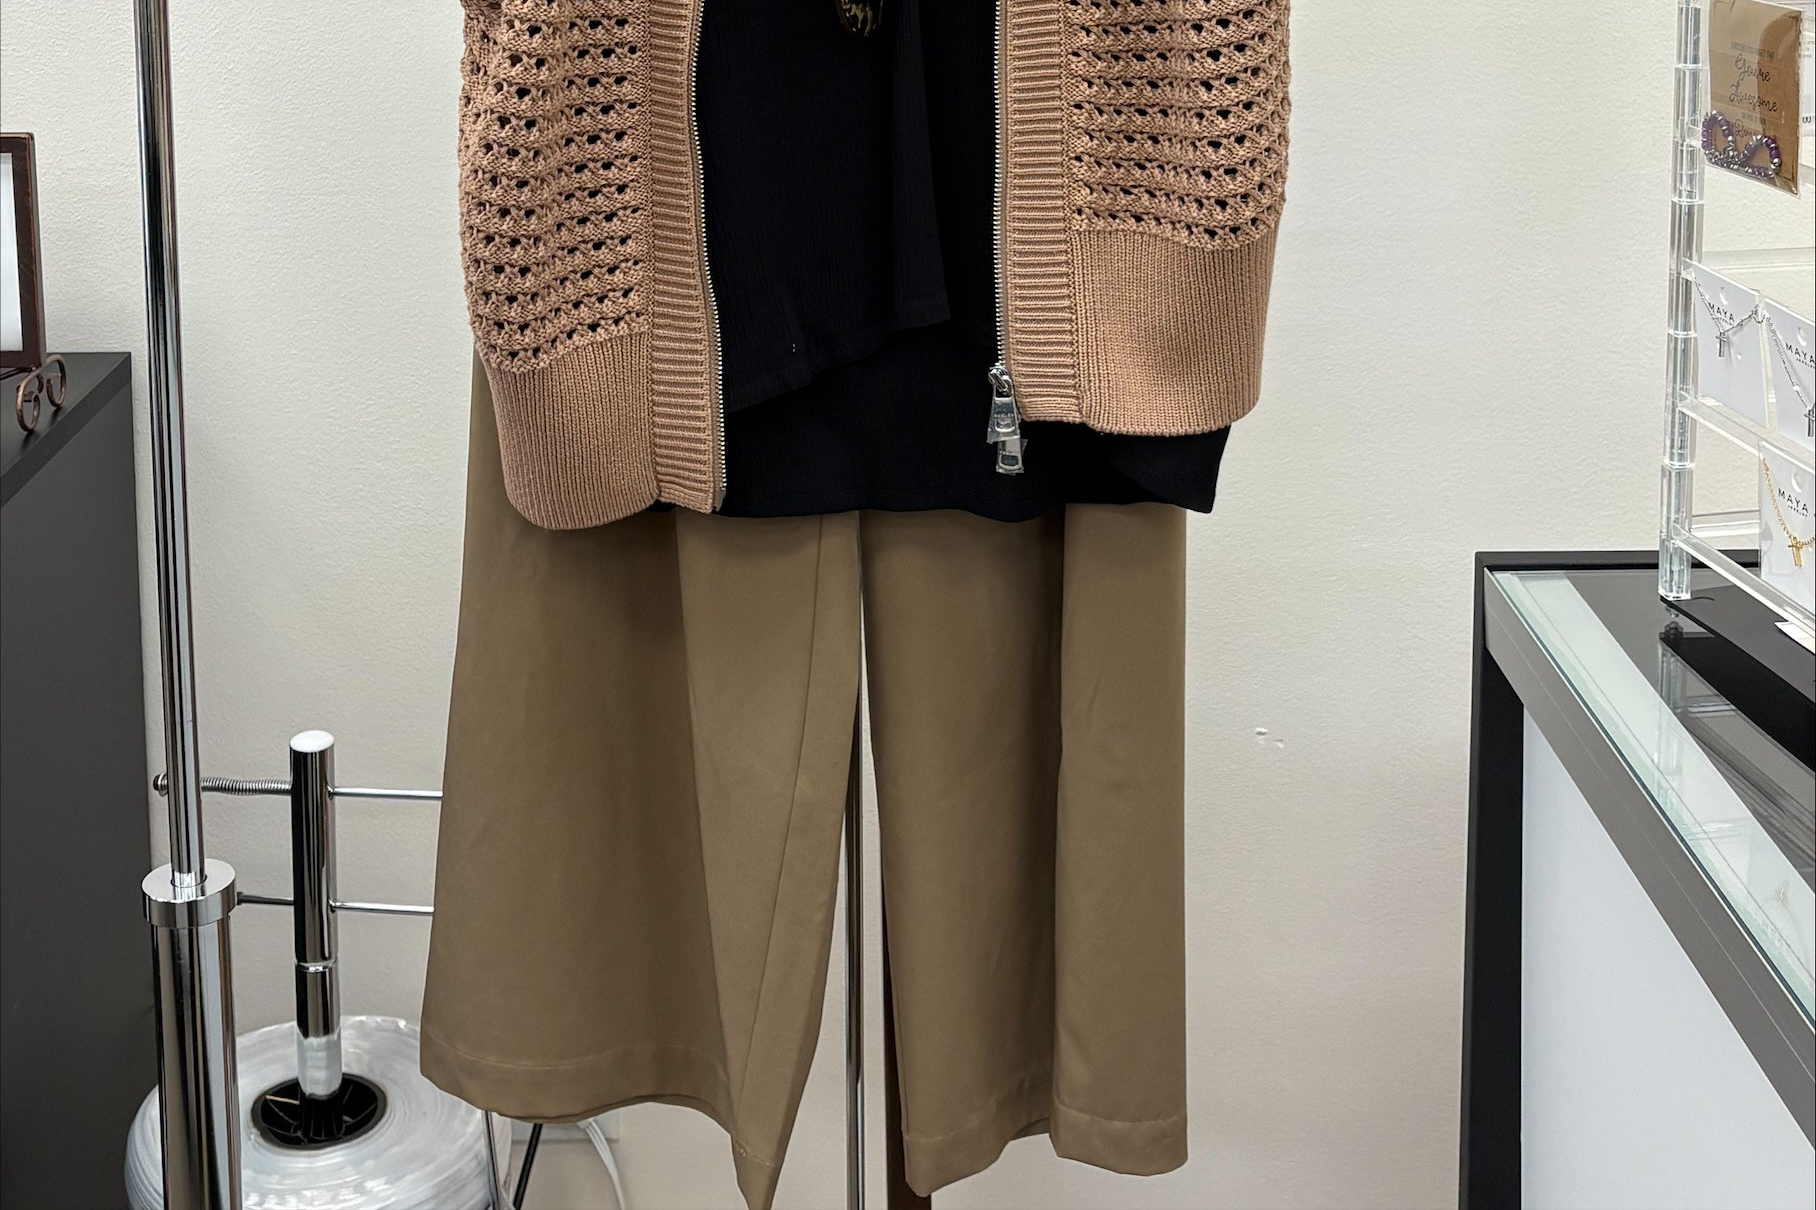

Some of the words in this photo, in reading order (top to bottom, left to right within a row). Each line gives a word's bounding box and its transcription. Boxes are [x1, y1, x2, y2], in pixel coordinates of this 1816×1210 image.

[1708, 302, 1735, 322] MAYA
[1785, 342, 1815, 364] MAYA
[1778, 487, 1809, 514] MAYA
